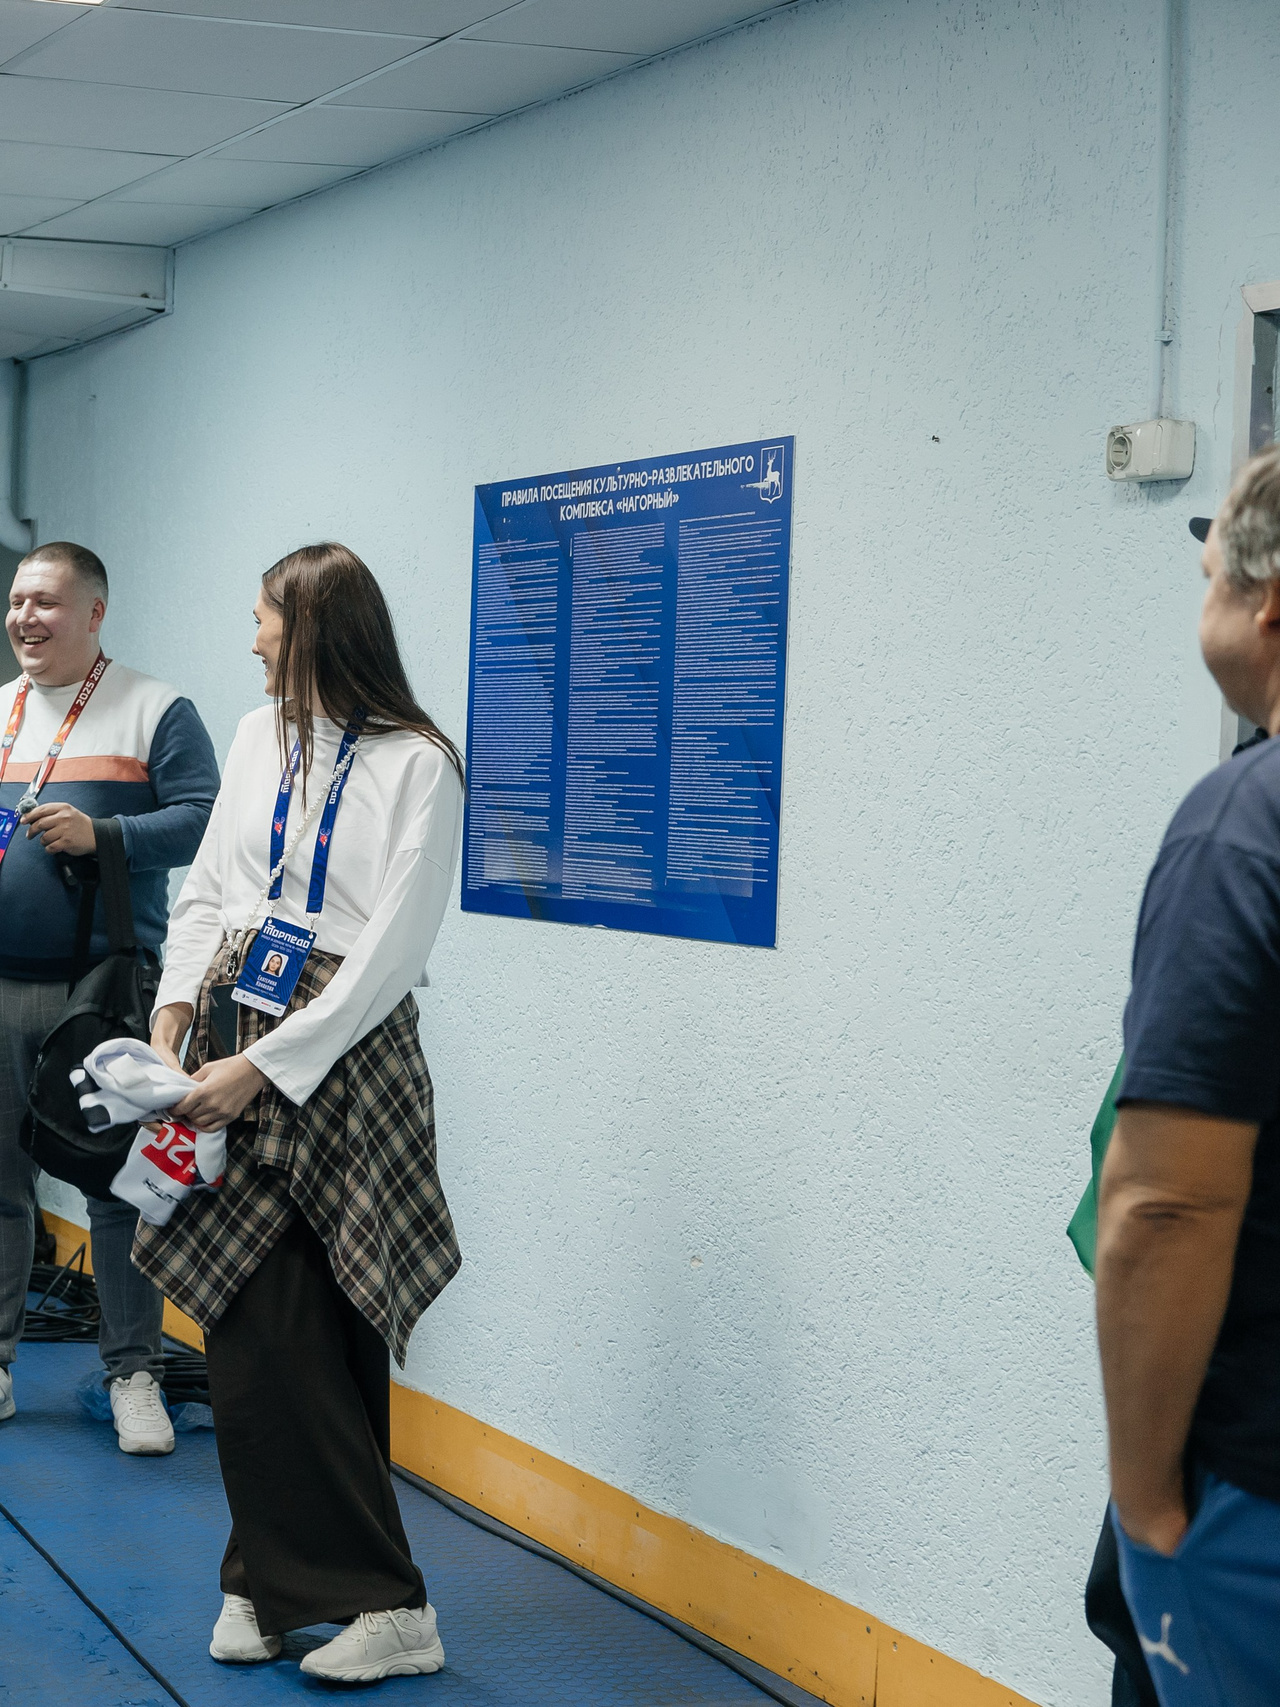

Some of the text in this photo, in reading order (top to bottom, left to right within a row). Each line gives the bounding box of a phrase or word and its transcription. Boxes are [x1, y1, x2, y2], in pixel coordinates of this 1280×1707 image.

[501, 455, 755, 507] ПРАВИЛА ПОСЕЩЕНИЯ КУЛЬТУРНО-РАЗВЛЕКАТЕЛЬНОГО
[559, 488, 679, 521] КОМПЛЕКСА «НАГОРНЫЙ»
[76, 681, 95, 707] 2025
